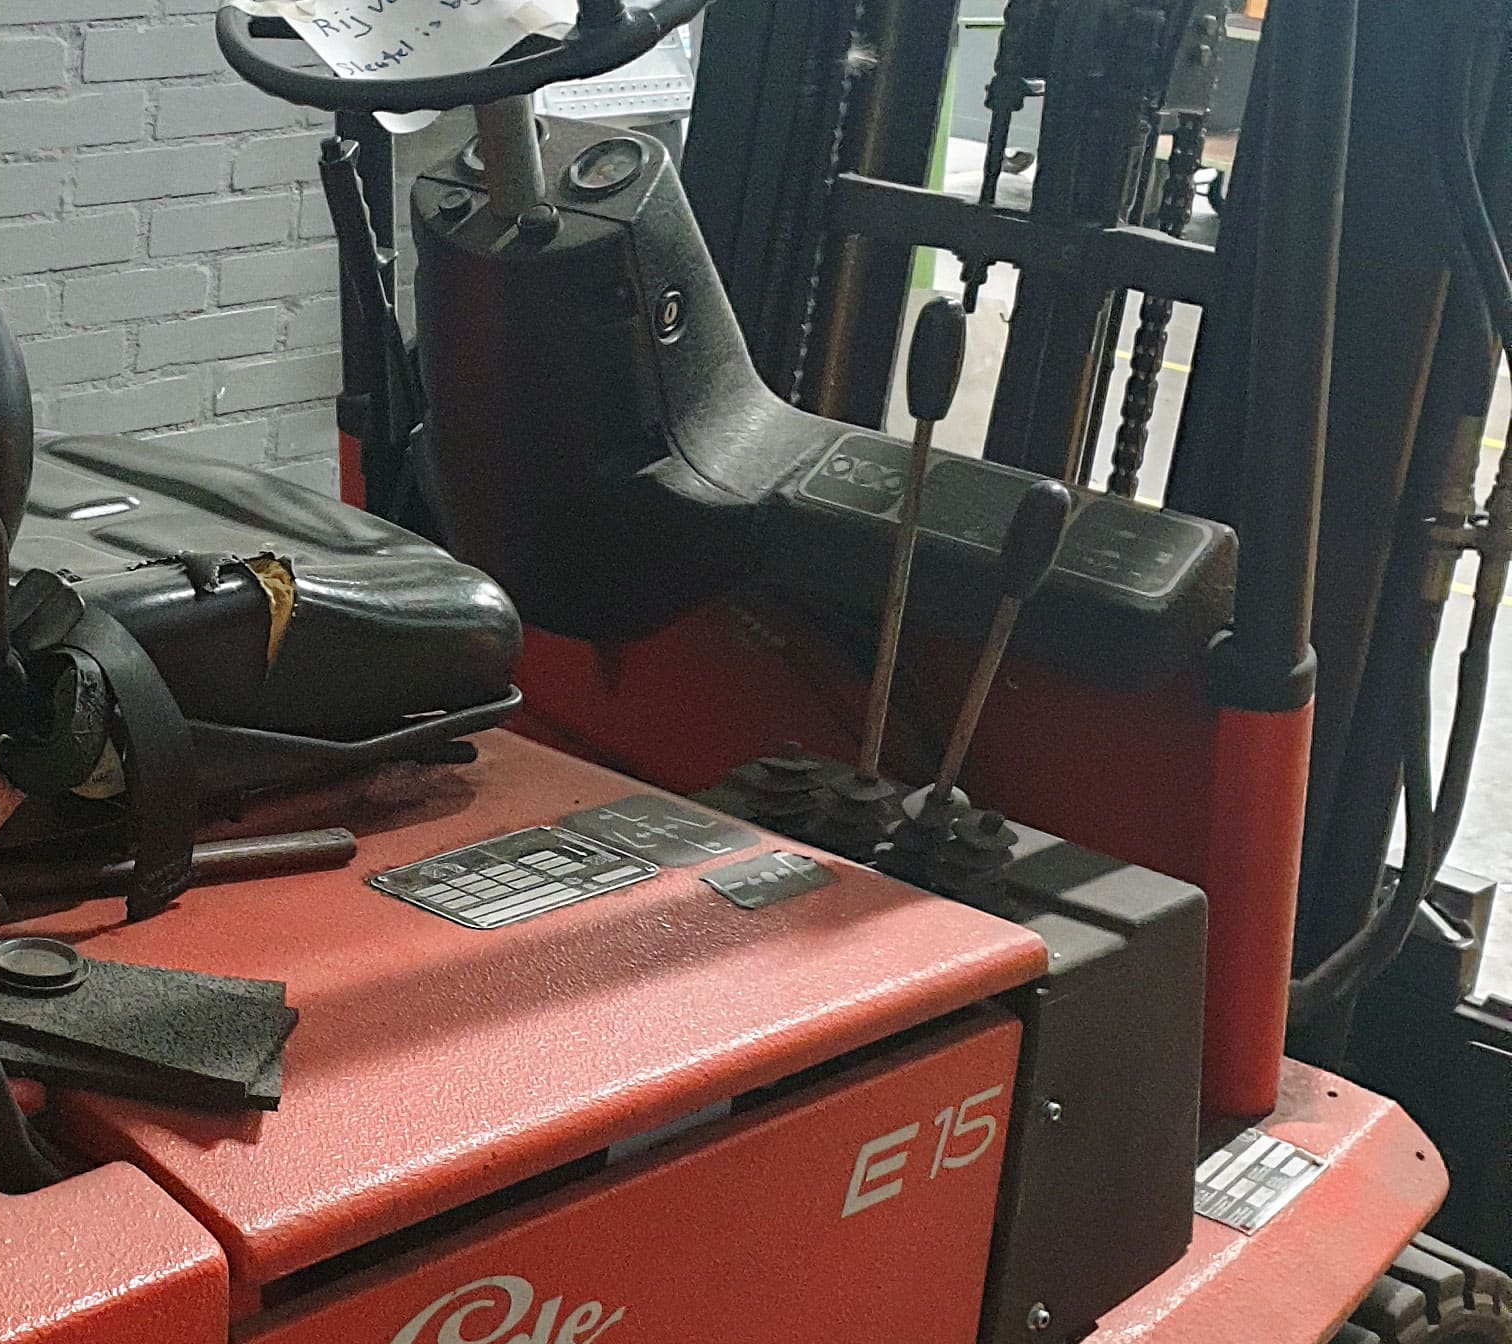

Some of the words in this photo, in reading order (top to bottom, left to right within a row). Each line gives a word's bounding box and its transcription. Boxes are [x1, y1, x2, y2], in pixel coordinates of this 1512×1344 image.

[335, 40, 415, 76] Sleutel
[841, 1121, 920, 1219] E
[929, 1083, 1004, 1180] 15
